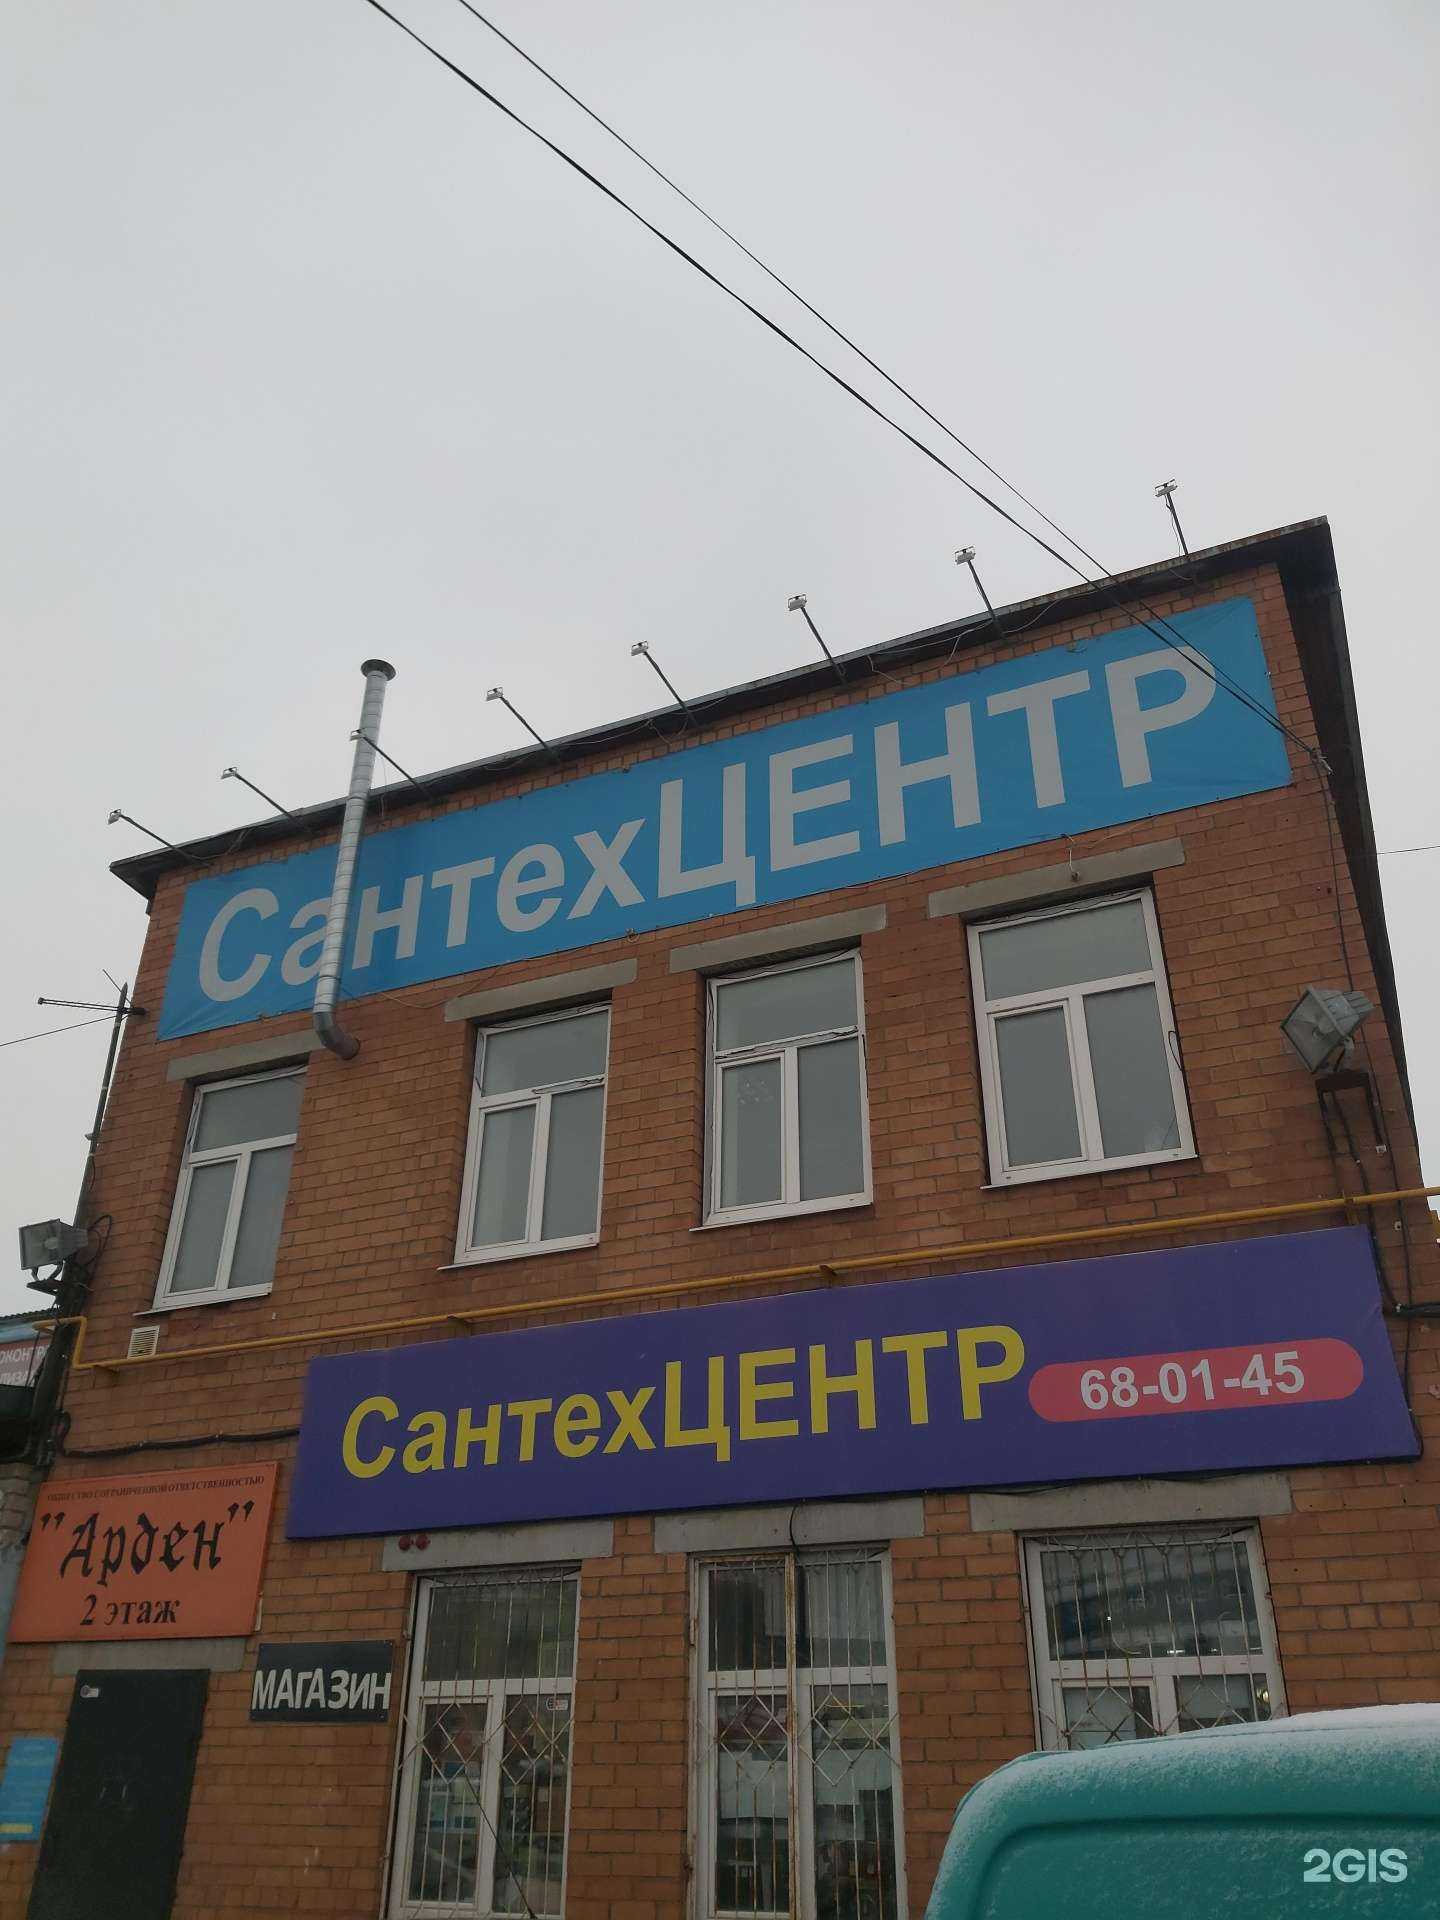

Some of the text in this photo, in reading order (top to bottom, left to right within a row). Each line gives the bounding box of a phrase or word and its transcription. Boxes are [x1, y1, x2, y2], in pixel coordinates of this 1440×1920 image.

[199, 645, 1216, 1002] СантехЦЕНТР
[342, 1325, 1025, 1478] СантехЦЕНТР
[1080, 1350, 1305, 1410] 68-01-45
[80, 1595, 181, 1625] 2 этаж
[252, 1668, 391, 1710] МАГАЗИН
